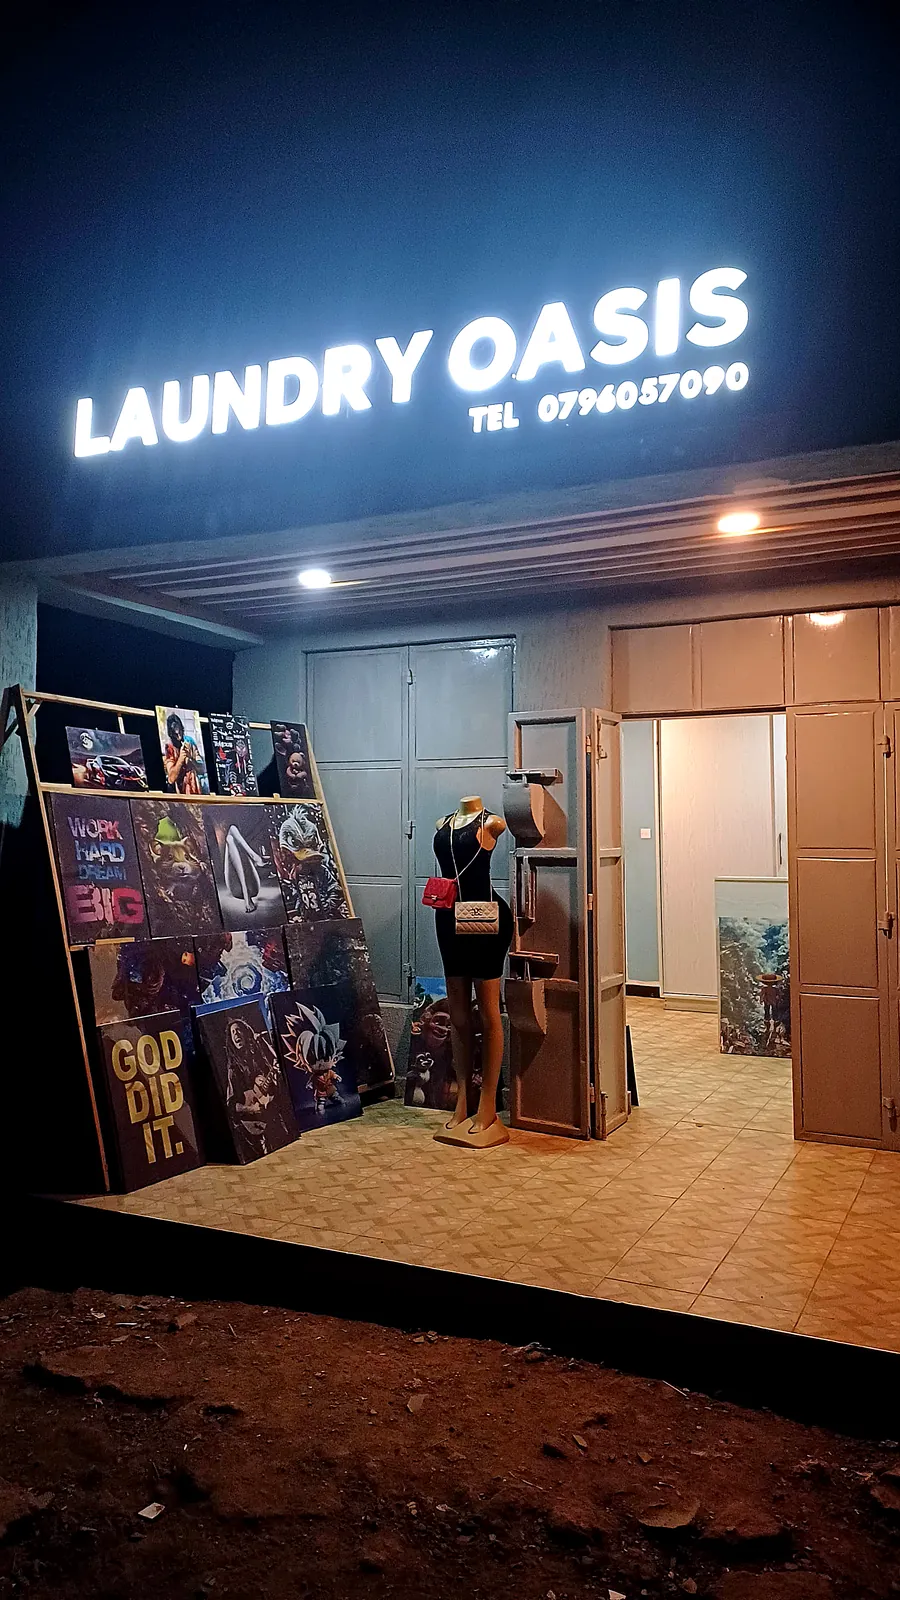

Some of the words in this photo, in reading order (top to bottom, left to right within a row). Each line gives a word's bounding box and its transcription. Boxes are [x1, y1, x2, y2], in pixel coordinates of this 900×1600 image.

[74, 330, 433, 457] LAUNDRY
[448, 267, 749, 391] OASIS
[469, 402, 520, 433] TEL
[537, 361, 749, 422] 0796057090
[67, 817, 123, 841] WORK
[75, 840, 126, 863] HARD
[78, 864, 127, 880] DREAM
[68, 884, 144, 925] BIG
[112, 1030, 183, 1082] GOD
[125, 1072, 184, 1124] DID
[142, 1115, 184, 1164] IT.
